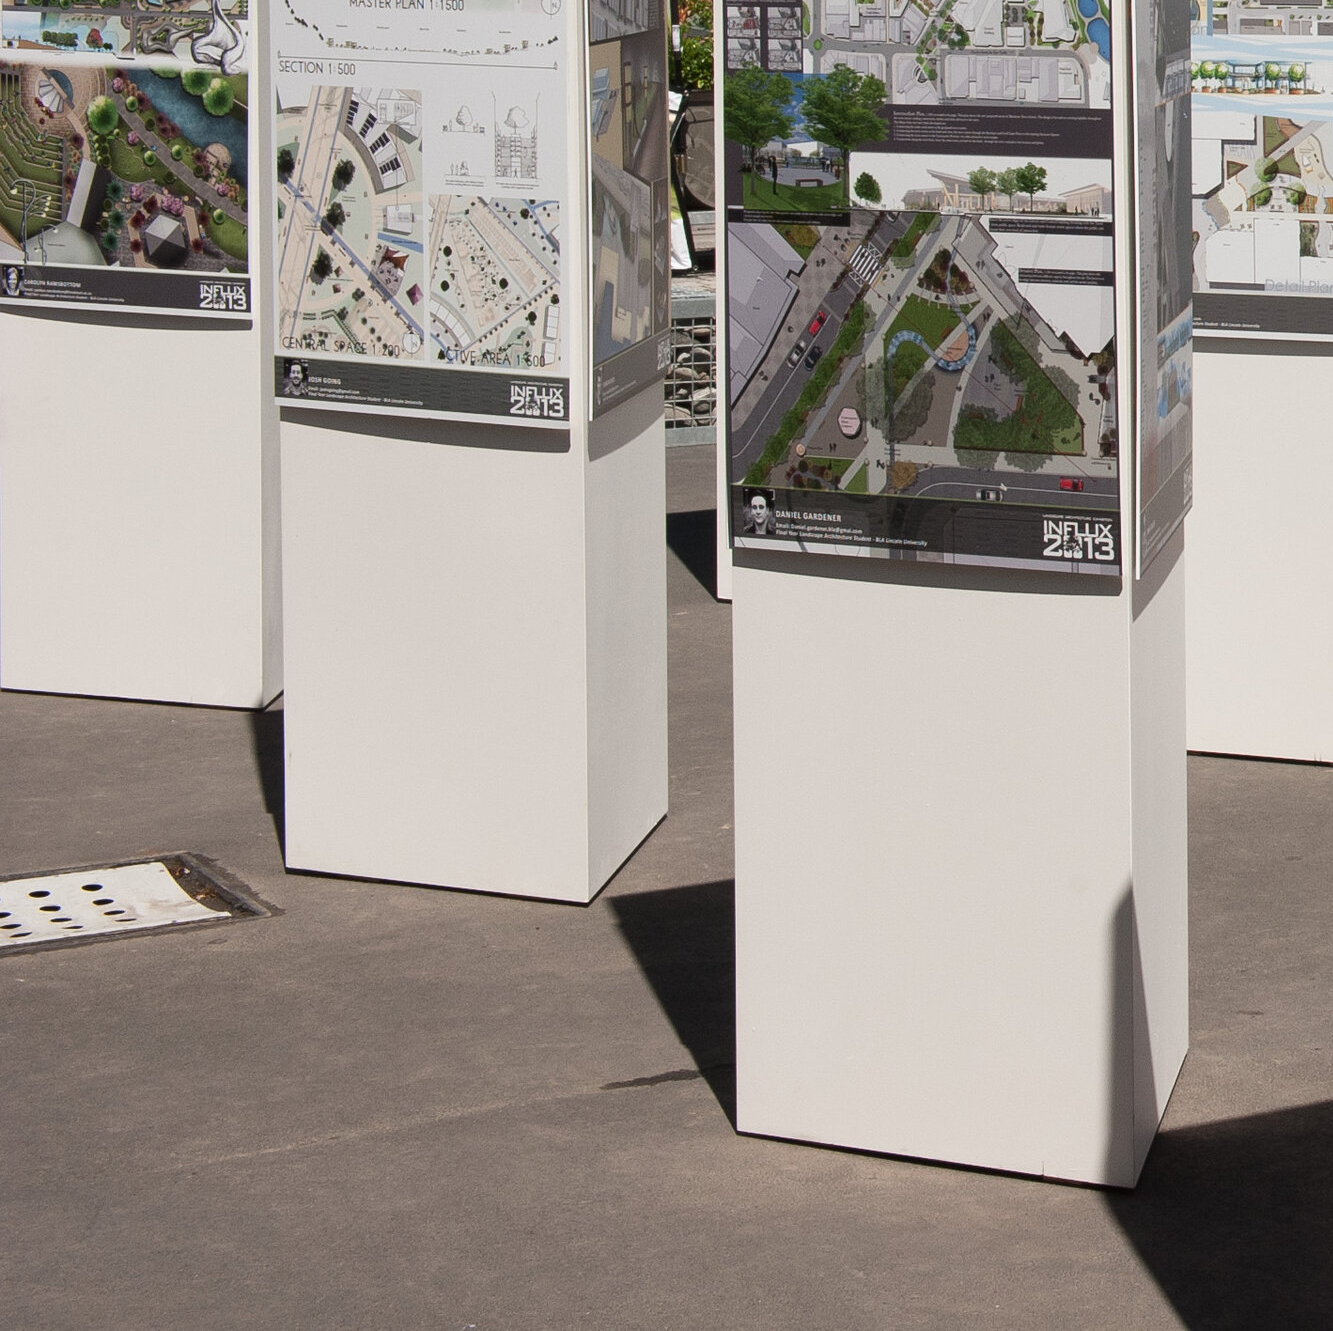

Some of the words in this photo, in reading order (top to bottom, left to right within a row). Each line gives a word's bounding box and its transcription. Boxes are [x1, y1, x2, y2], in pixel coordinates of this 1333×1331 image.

[279, 60, 324, 75] SECTION
[328, 63, 356, 76] 1:500
[200, 284, 245, 296] INFLUX
[1265, 278, 1306, 291] Detail
[282, 337, 330, 352] CENTRAL
[333, 341, 367, 355] SPACE
[438, 349, 481, 365] CTIVE
[481, 352, 511, 367] AREA
[510, 384, 563, 399] INFLUX
[775, 510, 801, 519] DANIEL
[802, 512, 842, 523] GARDENER
[1043, 519, 1114, 539] INFLUX
